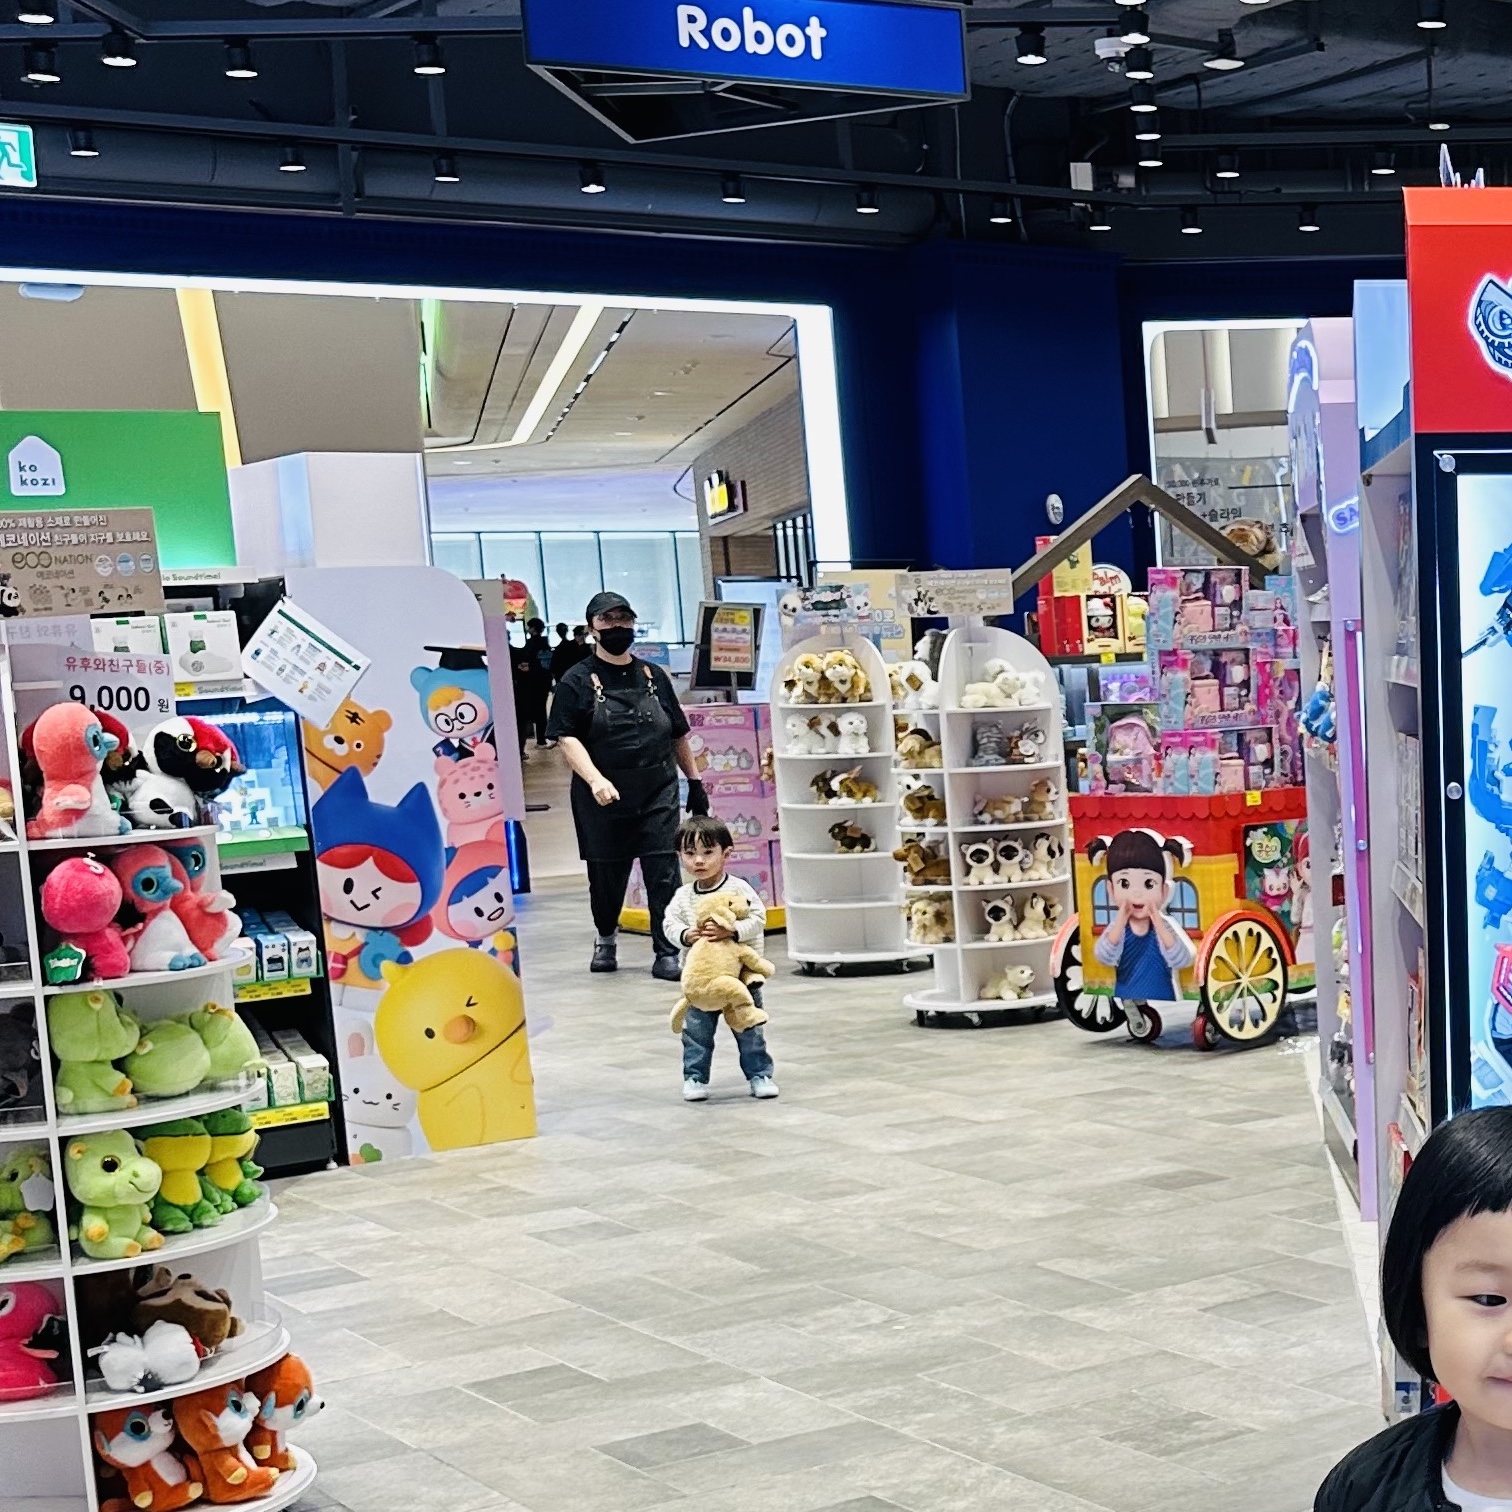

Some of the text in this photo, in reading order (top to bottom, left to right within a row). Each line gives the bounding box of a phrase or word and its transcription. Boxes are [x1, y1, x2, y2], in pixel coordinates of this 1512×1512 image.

[677, 4, 827, 60] Robot
[18, 461, 37, 472] ko
[20, 475, 56, 487] kozi
[54, 553, 93, 566] NATION
[69, 684, 169, 713] 9,000 원
